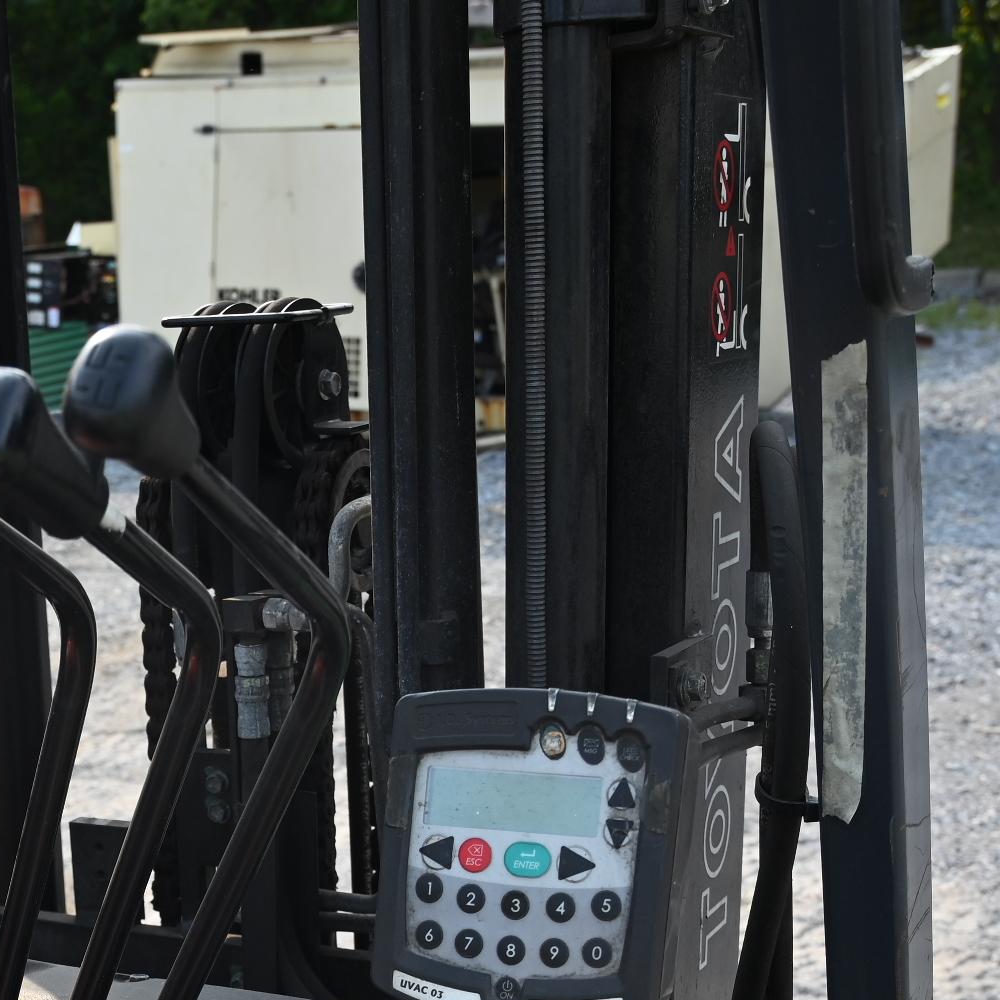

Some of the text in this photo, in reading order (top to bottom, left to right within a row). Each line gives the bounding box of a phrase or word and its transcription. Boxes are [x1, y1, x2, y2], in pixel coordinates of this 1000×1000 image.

[465, 858, 482, 867] ESC
[513, 860, 541, 870] ENTER
[427, 882, 611, 915] 1 2 3 4 5
[425, 929, 602, 960] 6 7 8 9 0
[400, 979, 443, 999] UVAC 03
[500, 991, 513, 999] ON
